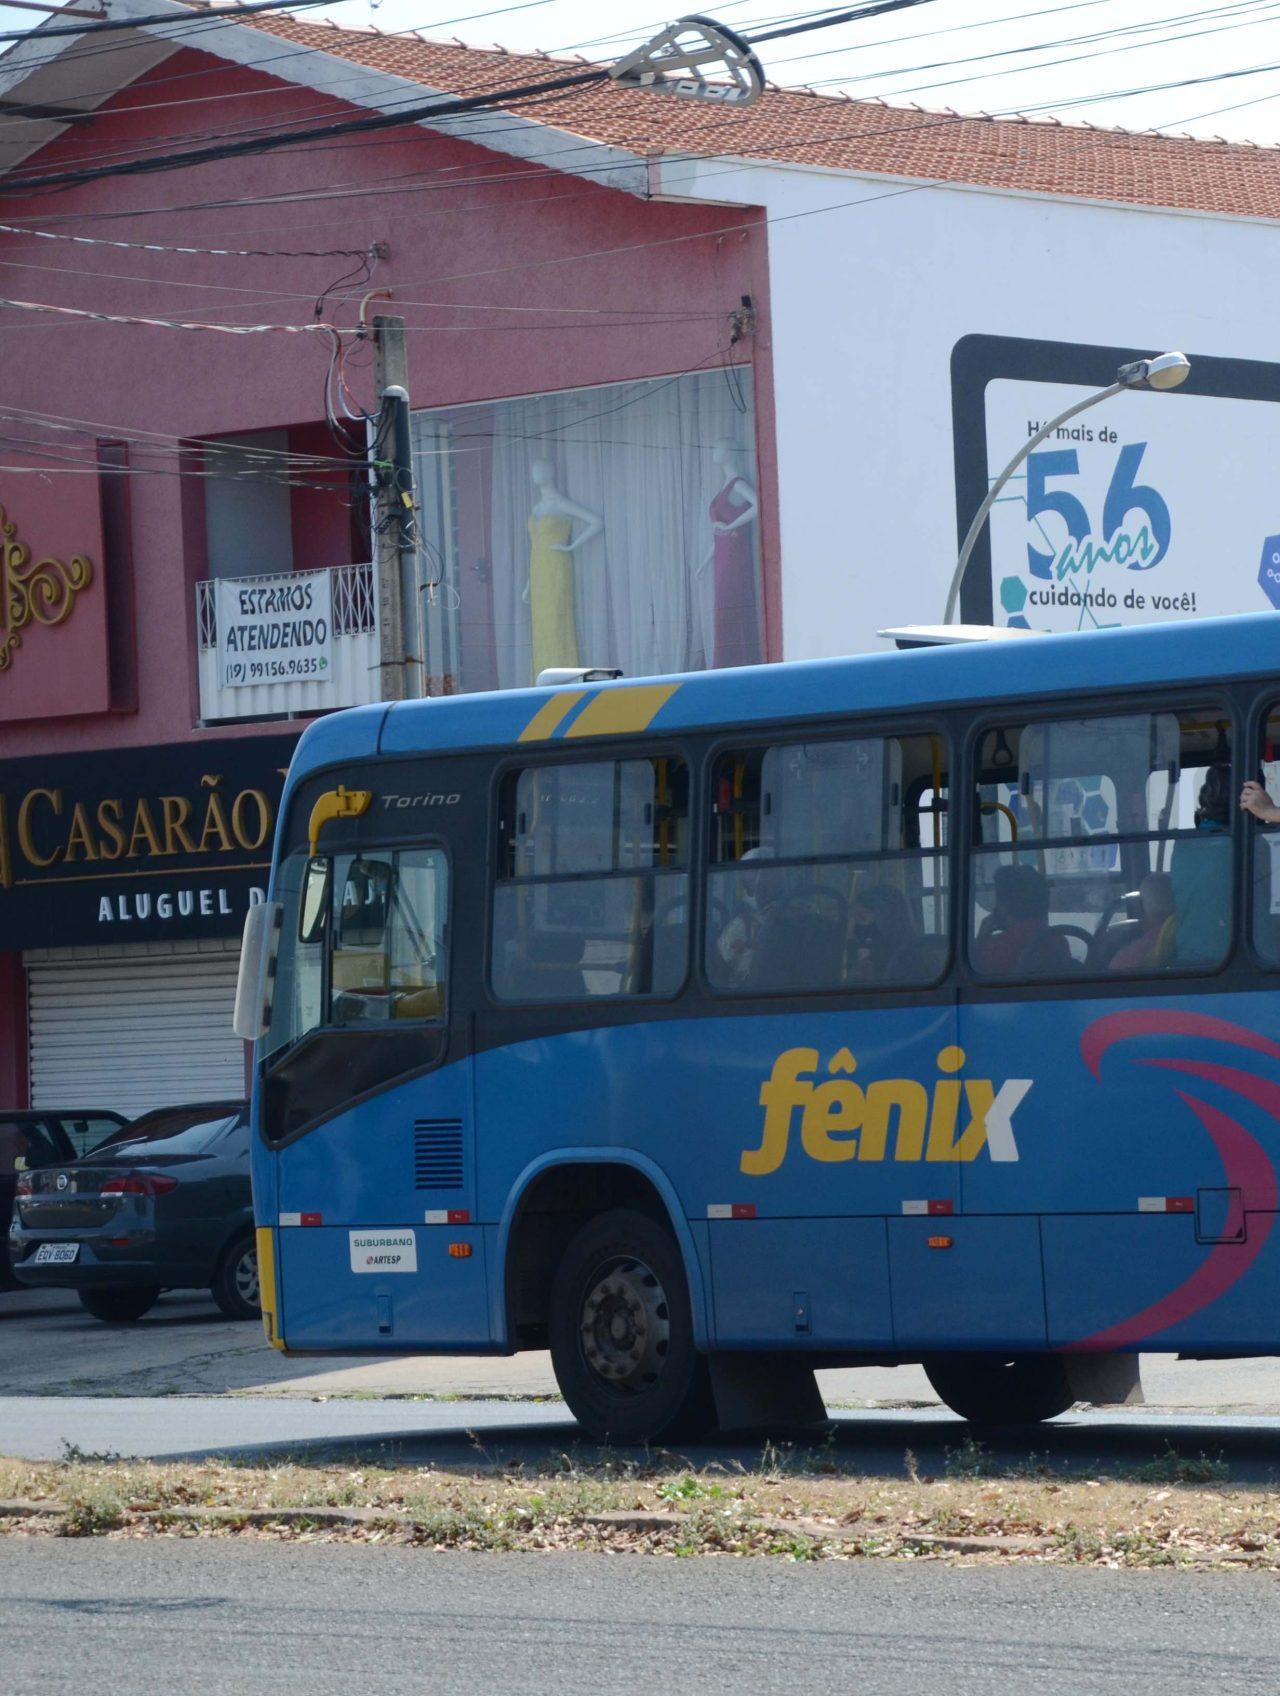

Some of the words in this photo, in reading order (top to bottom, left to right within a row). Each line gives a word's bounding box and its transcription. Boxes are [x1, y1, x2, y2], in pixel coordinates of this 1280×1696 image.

[1027, 420, 1050, 438] H
[1056, 424, 1093, 442] mais
[1098, 426, 1118, 444] de
[1026, 441, 1172, 580] 56
[1055, 524, 1155, 582] anos
[239, 583, 313, 615] ESTAMOS
[1028, 585, 1117, 608] cuidando
[1123, 588, 1145, 609] de
[1151, 591, 1196, 612] você!
[226, 618, 327, 652] ATENDENDO
[226, 663, 246, 684] (19)
[250, 658, 317, 678] 99156.9635
[381, 792, 461, 809] Torino
[17, 773, 272, 867] CASARÃO
[98, 888, 233, 923] ALUGUEL
[738, 1044, 1035, 1177] fênix
[353, 1237, 413, 1247] SUBURBANO
[373, 1255, 401, 1265] ARTESP
